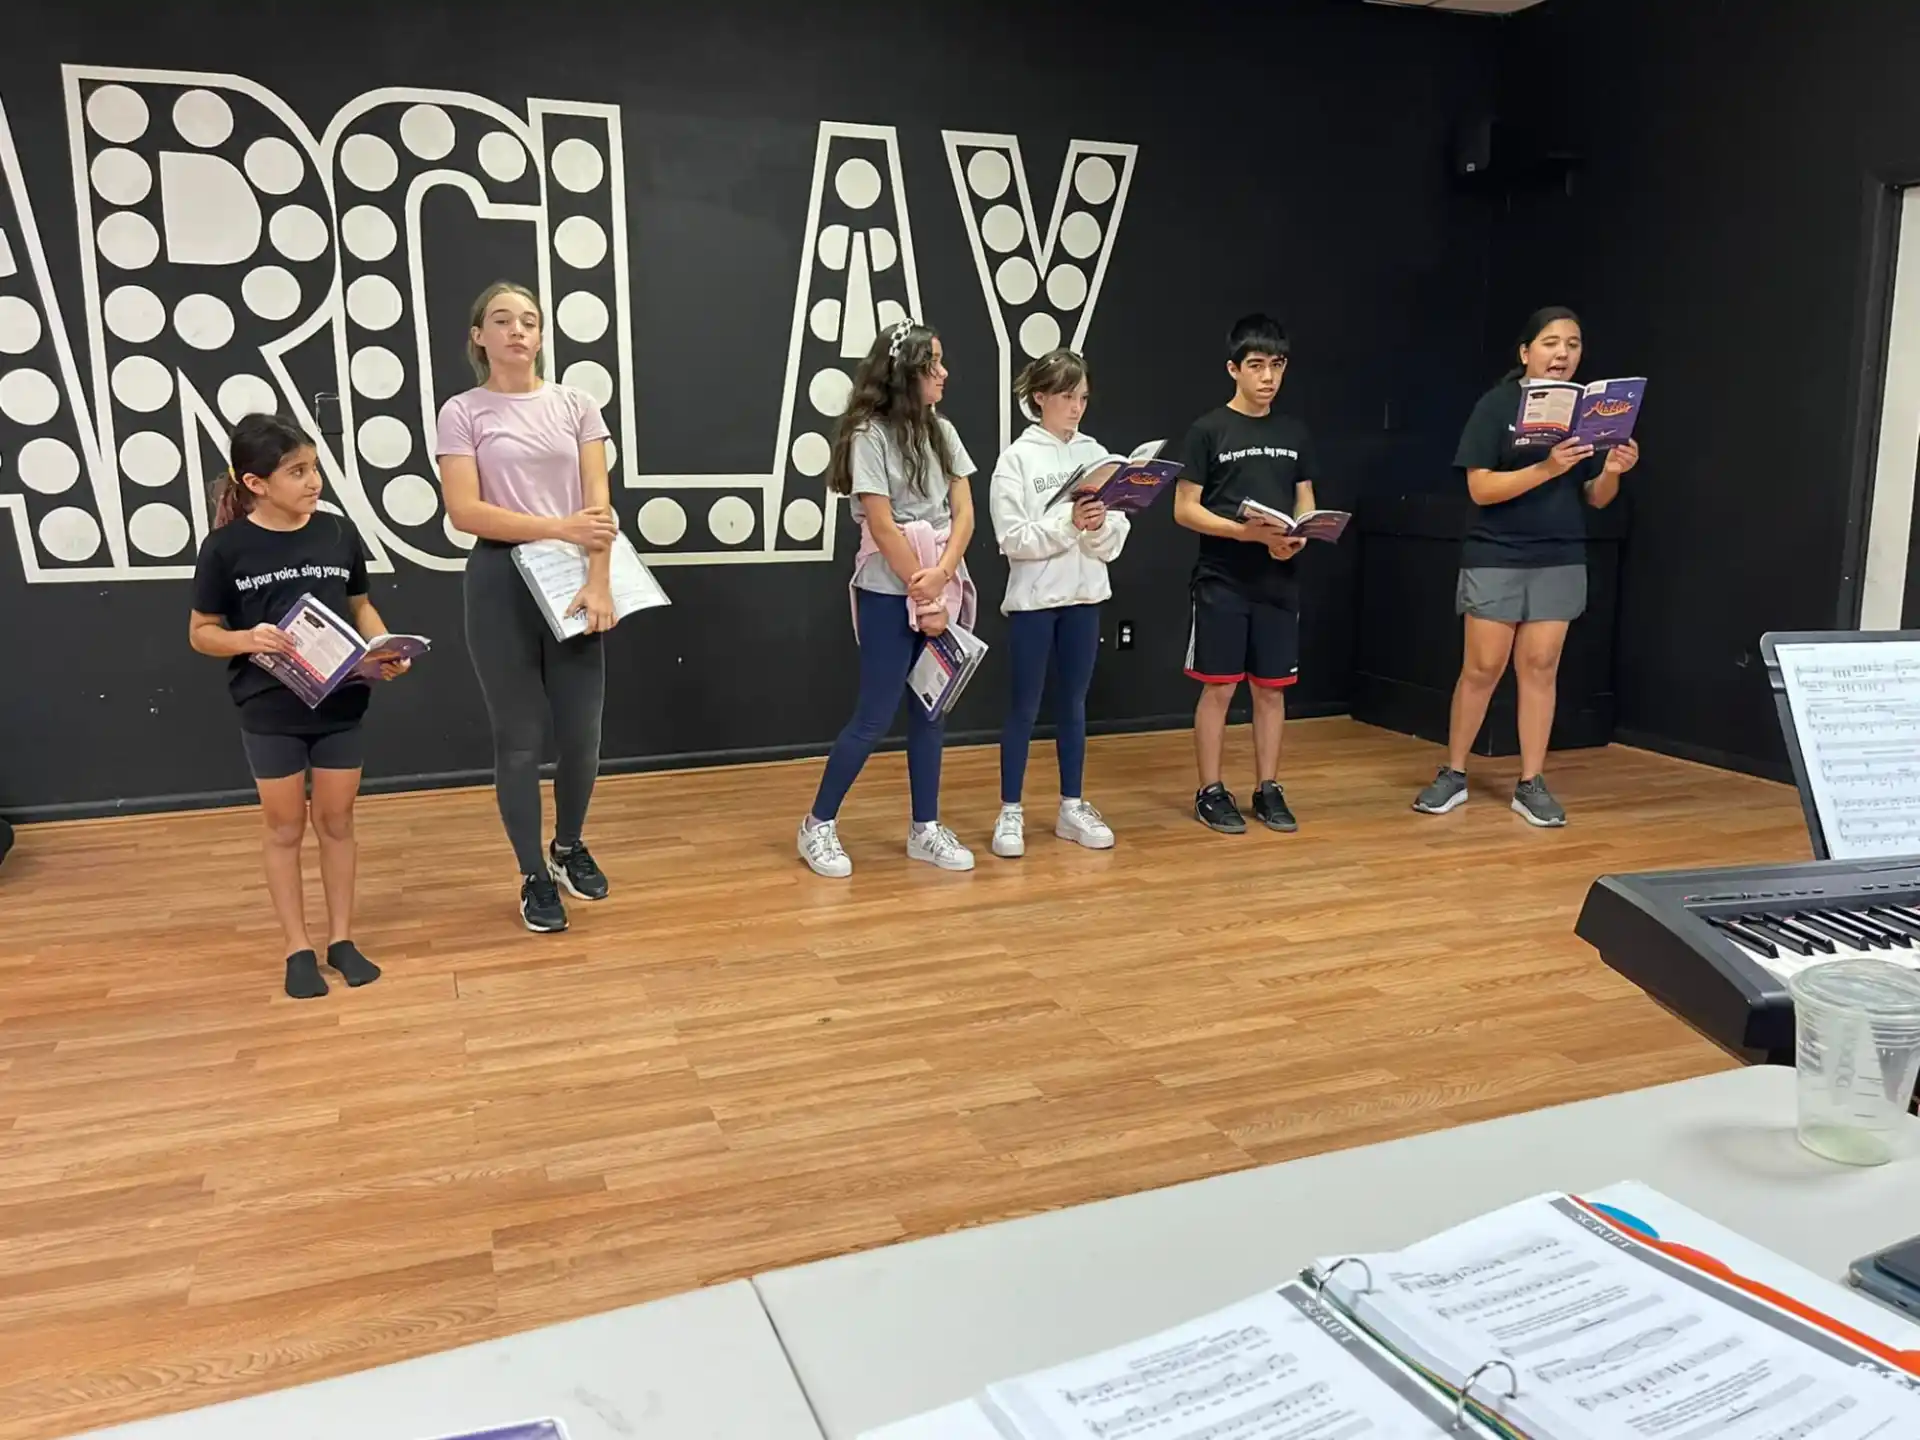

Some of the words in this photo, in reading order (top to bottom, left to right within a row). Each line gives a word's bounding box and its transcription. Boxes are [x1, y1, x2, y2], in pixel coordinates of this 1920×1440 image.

[235, 576, 253, 591] find
[252, 573, 273, 590] your
[301, 564, 321, 579] sing
[322, 565, 340, 578] your
[1571, 1211, 1636, 1249] SCRIPT
